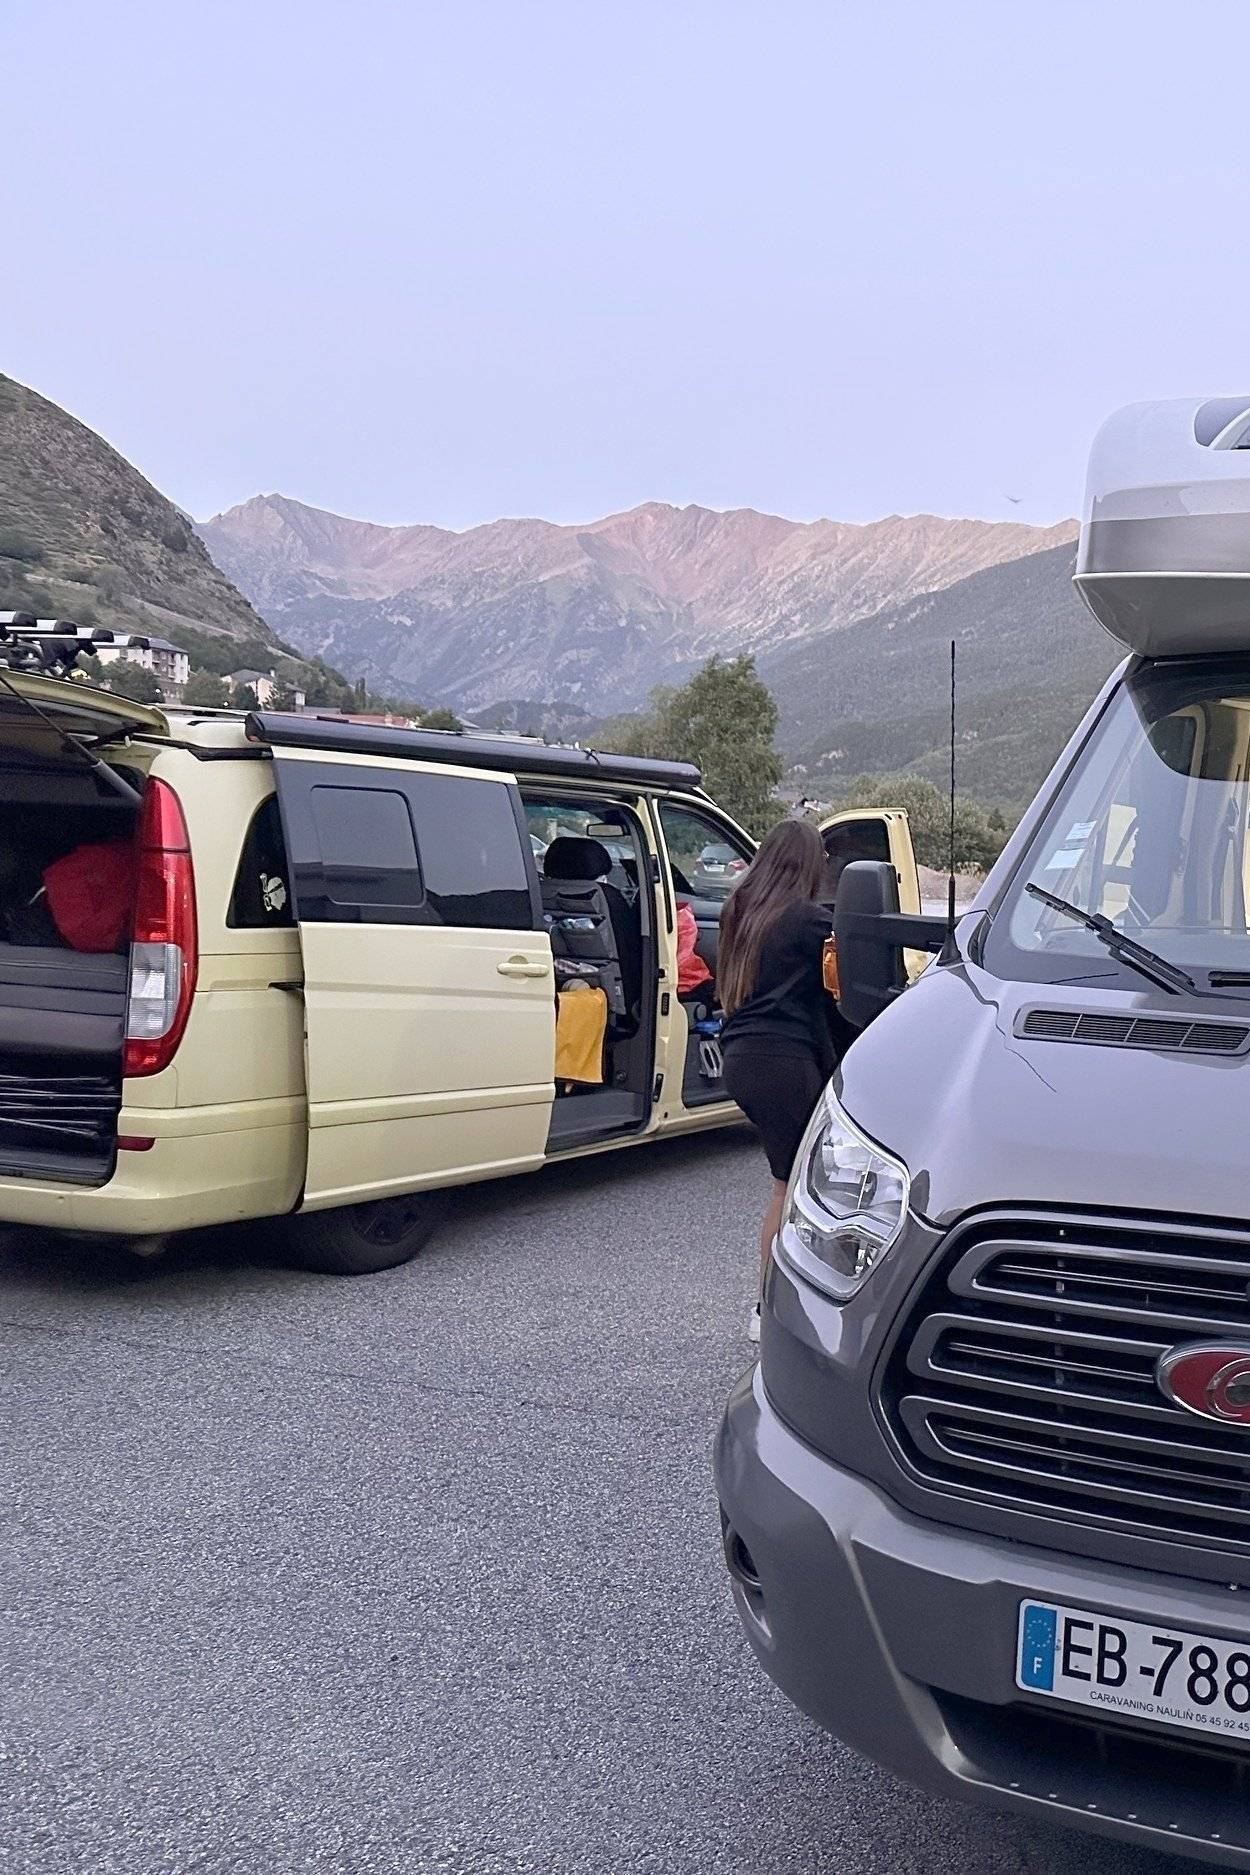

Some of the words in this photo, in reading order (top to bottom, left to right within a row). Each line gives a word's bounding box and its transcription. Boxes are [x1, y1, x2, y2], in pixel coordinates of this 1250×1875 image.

[1032, 1656, 1043, 1675] F
[1089, 1690, 1154, 1713] CARAVANING
[1156, 1705, 1194, 1721] NAULIN
[1195, 1713, 1207, 1724] 05
[1209, 1716, 1222, 1726] 45
[1223, 1719, 1236, 1729] 92
[1238, 1721, 1250, 1732] 45
